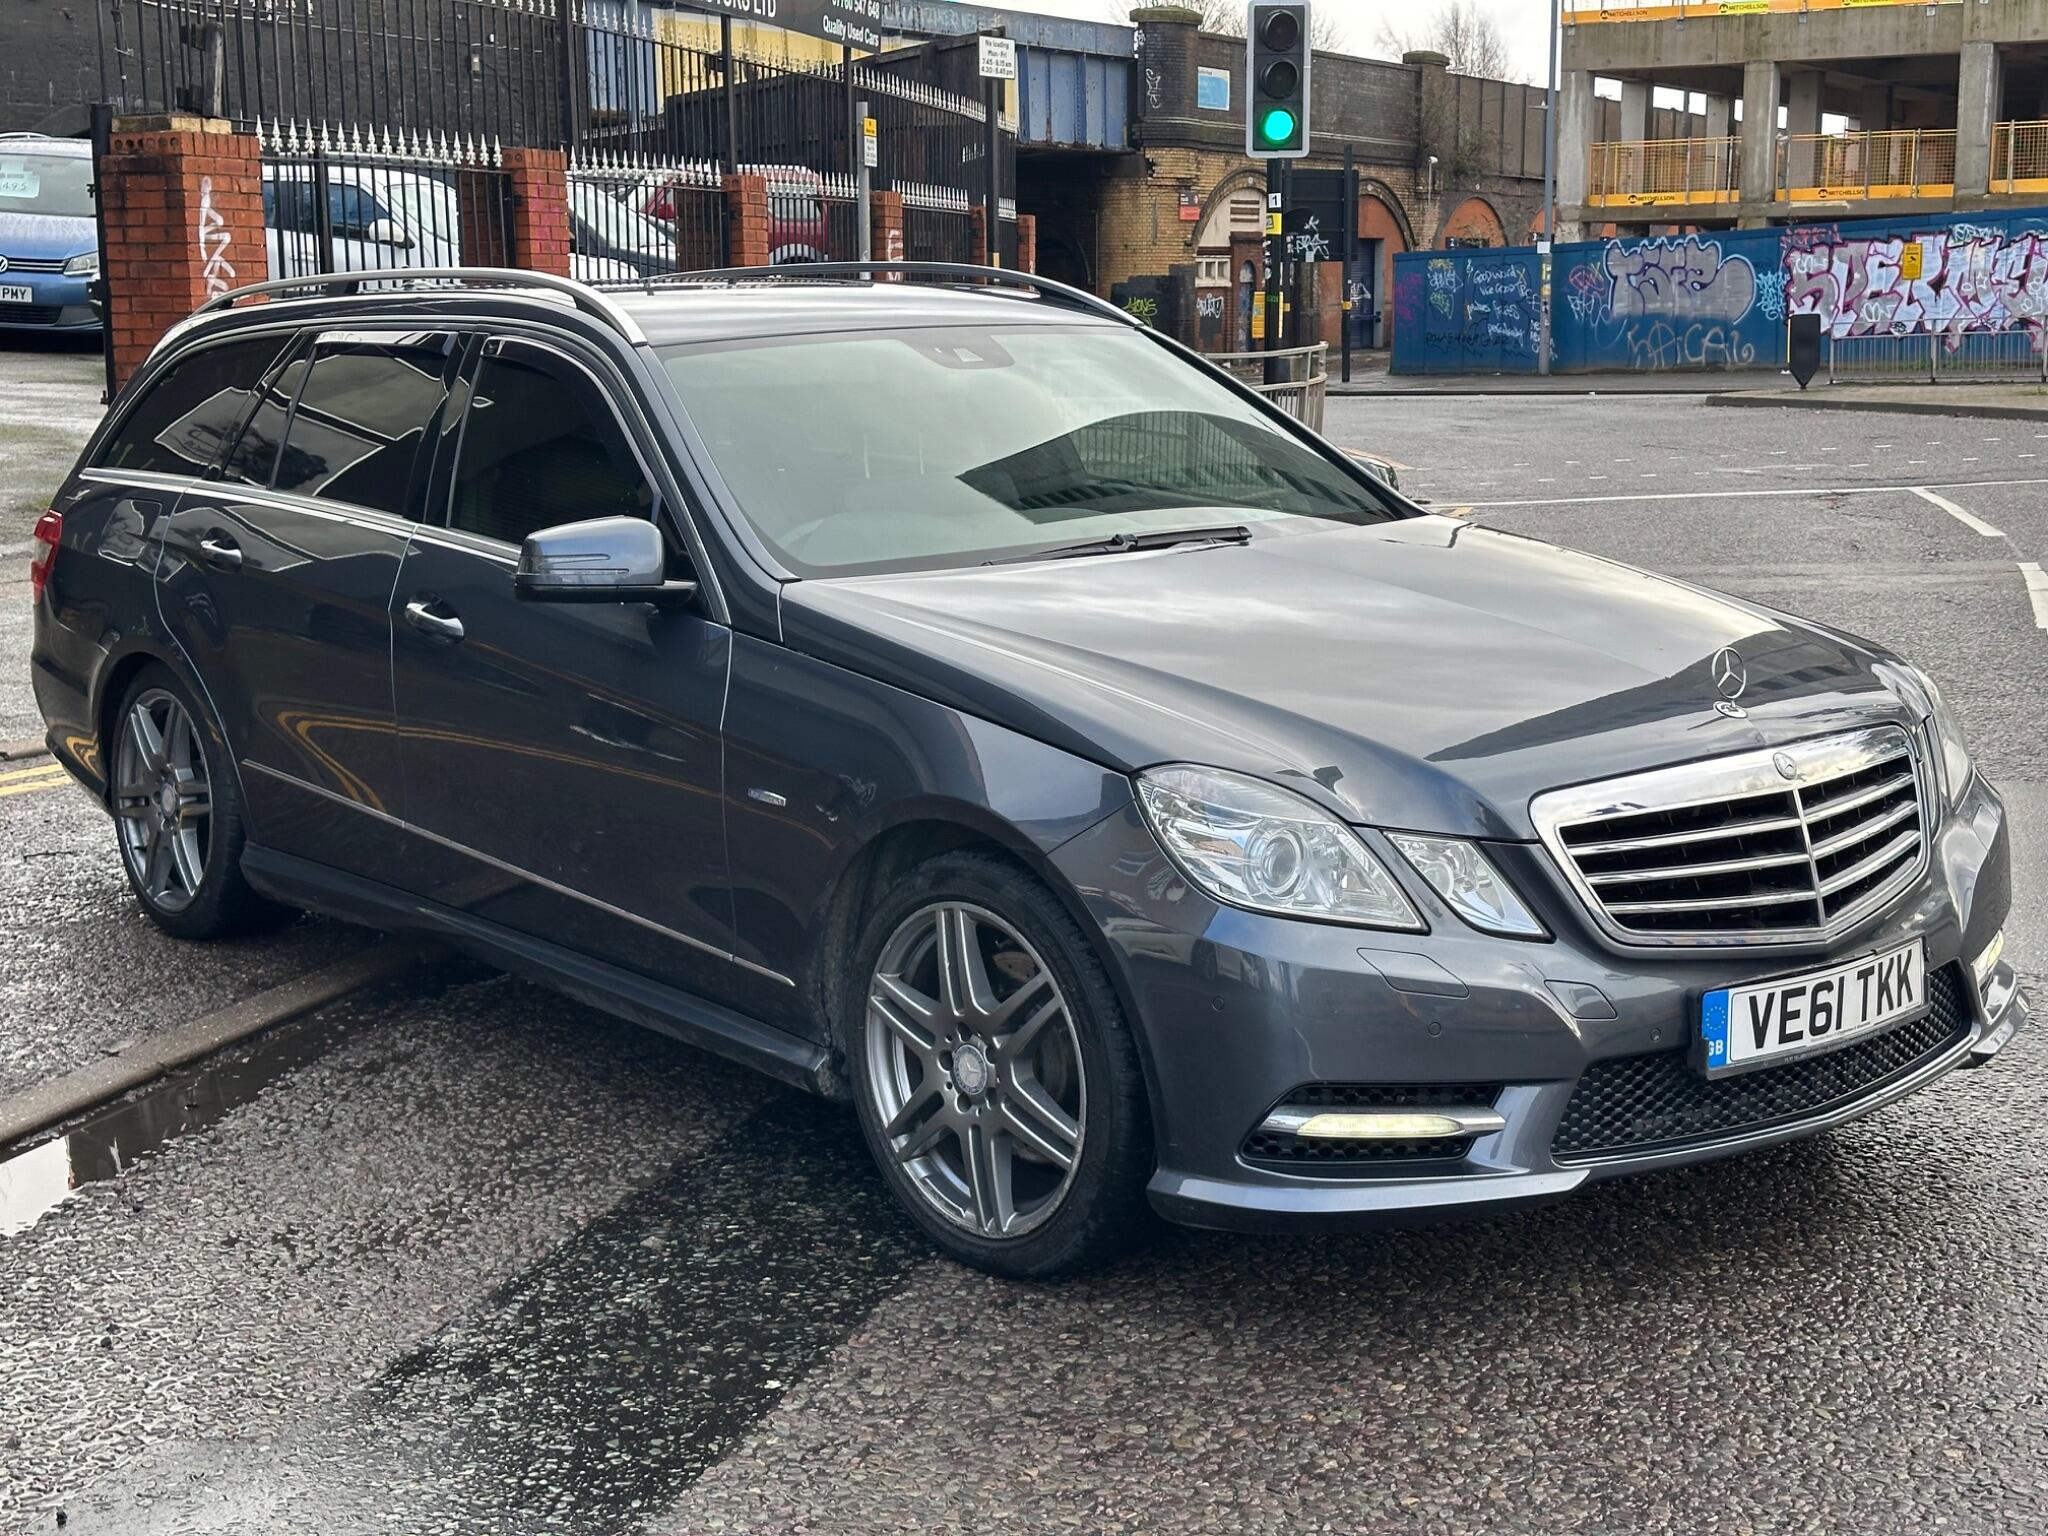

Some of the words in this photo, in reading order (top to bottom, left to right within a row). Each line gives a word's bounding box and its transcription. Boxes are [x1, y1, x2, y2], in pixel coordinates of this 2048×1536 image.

[823, 15, 846, 41] Quality
[847, 22, 864, 42] Used
[865, 28, 879, 47] Cars
[993, 40, 1009, 50] loading
[2, 287, 27, 300] PMY
[1749, 975, 1845, 1050] VE61
[1857, 949, 1913, 1022] TKK
